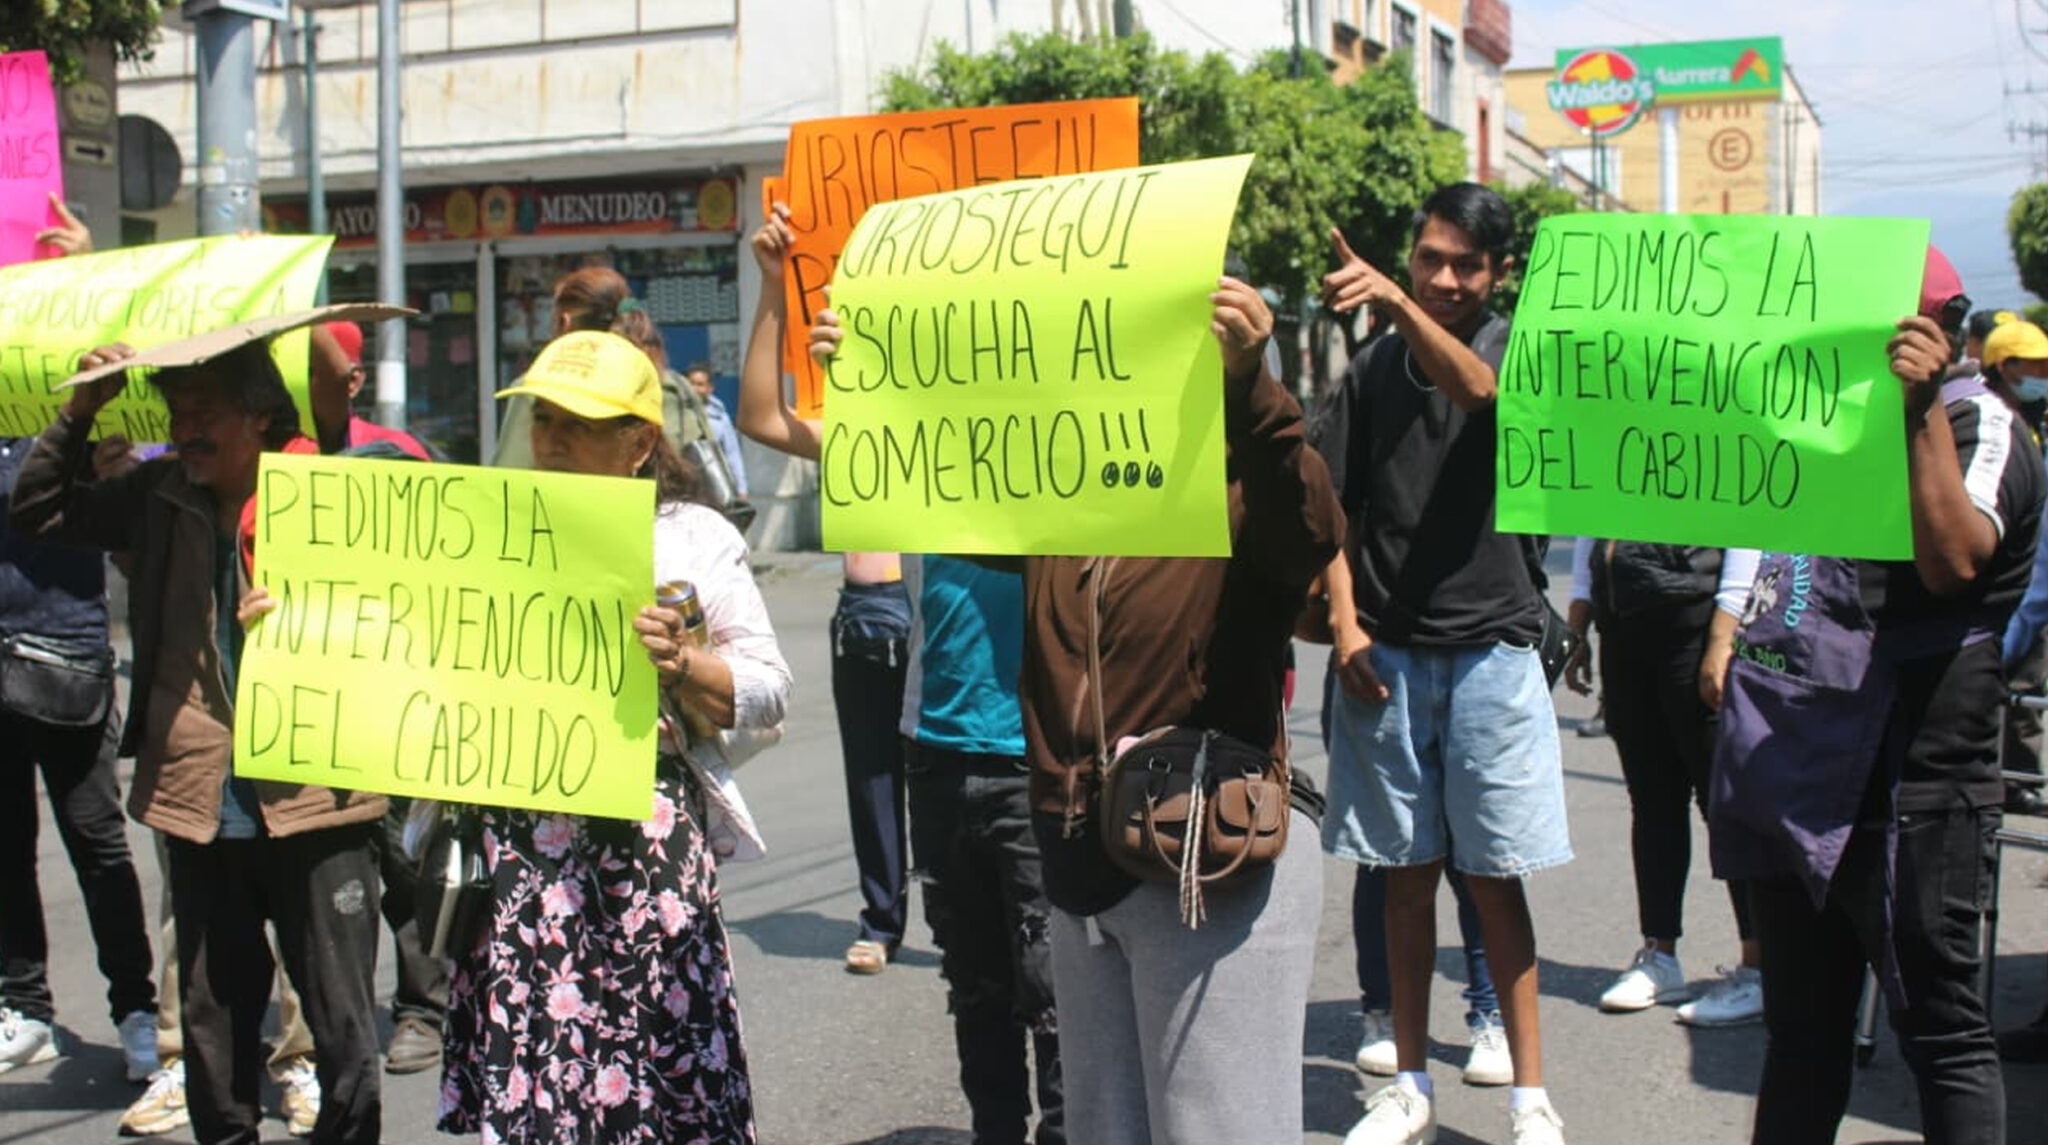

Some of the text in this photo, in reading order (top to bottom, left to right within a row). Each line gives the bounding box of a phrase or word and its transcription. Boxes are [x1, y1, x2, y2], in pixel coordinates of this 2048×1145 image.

[1548, 78, 1654, 109] Waldo's
[540, 192, 666, 224] MENUDEO
[843, 171, 1162, 280] URIOSTEGUI
[1520, 227, 1817, 322] PEDIMOS LA
[827, 299, 1039, 392] ESCUCHA
[1071, 297, 1132, 381] AL
[1504, 328, 1841, 428] INTERVENCION
[1503, 426, 1800, 510] DEL CABILDO
[263, 468, 558, 571] PEDIMOS LA
[255, 569, 626, 698] INTERVENCION
[250, 681, 597, 798] DEL CABILDO
